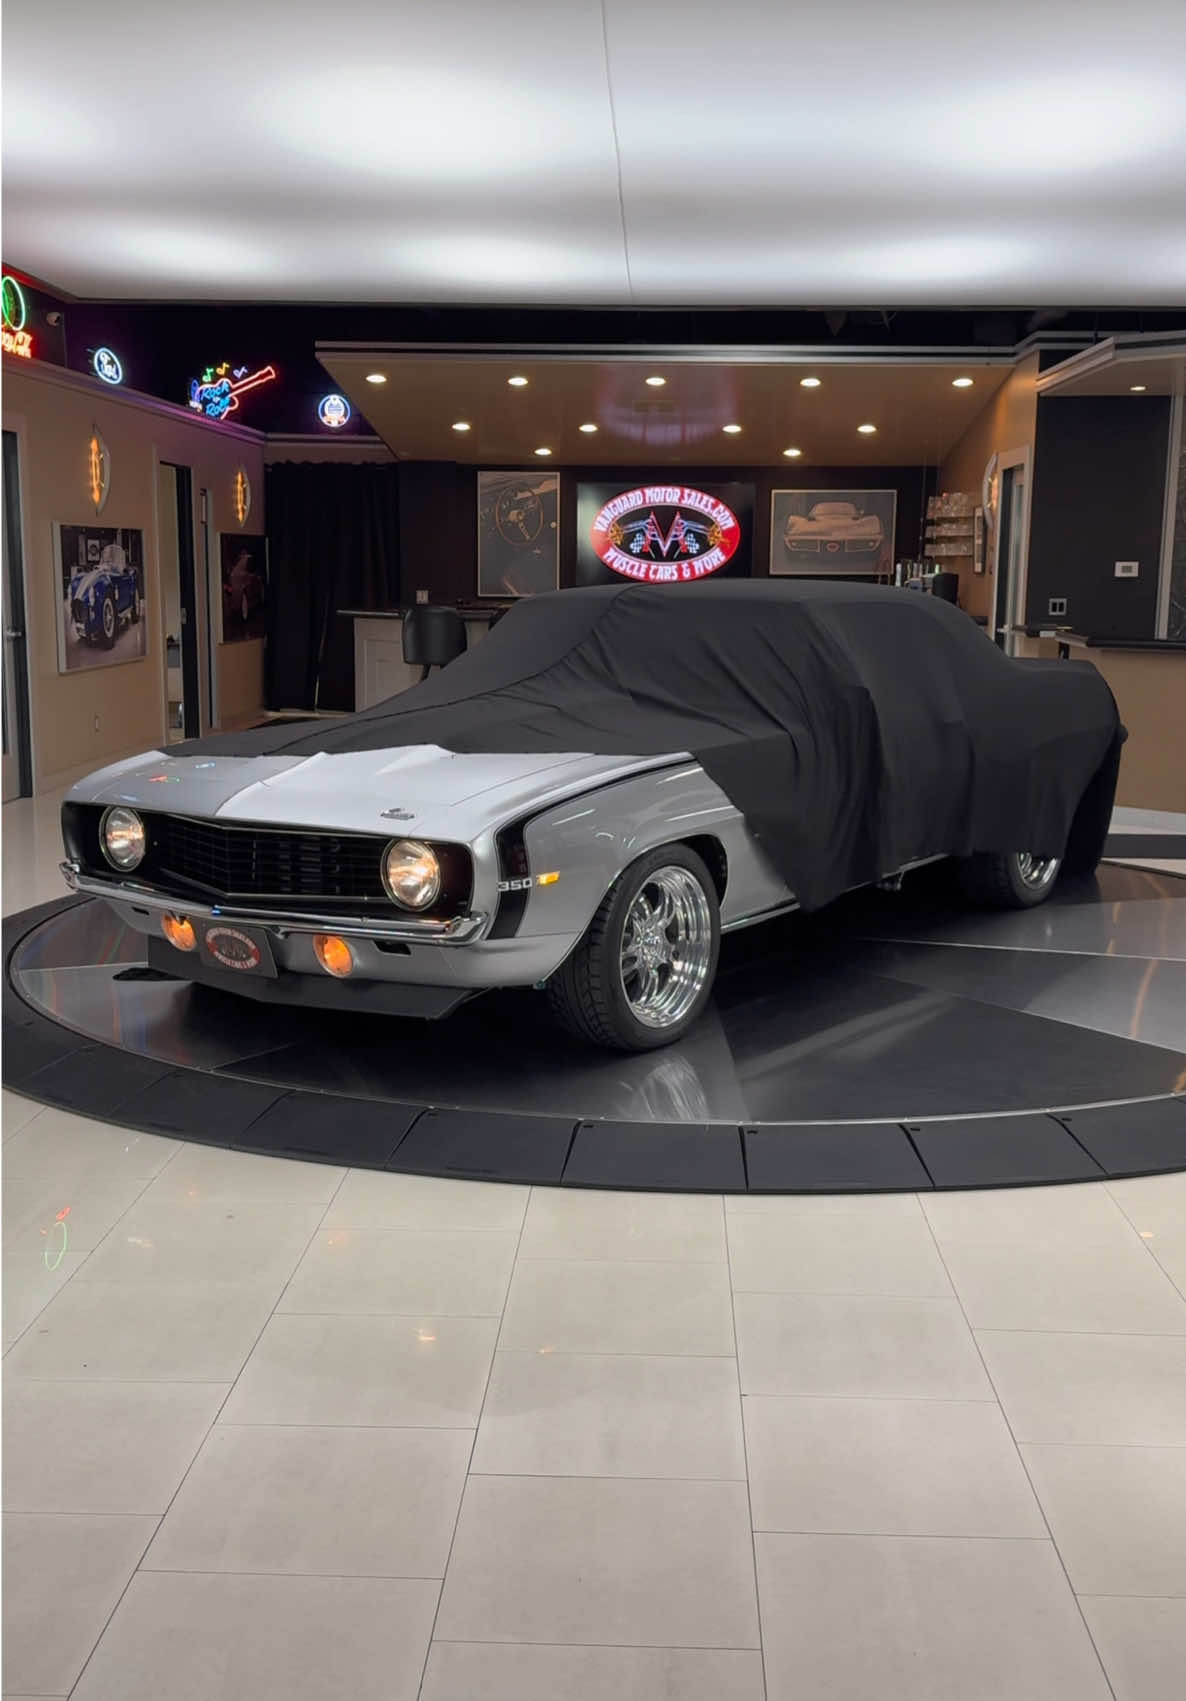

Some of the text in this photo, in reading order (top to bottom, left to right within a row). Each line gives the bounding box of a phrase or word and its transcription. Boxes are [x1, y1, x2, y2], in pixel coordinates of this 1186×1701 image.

[594, 487, 735, 532] VANGUARD MOTOR SALES.COM
[602, 547, 726, 580] MUSCLE CARS & MORE
[497, 877, 533, 892] 350
